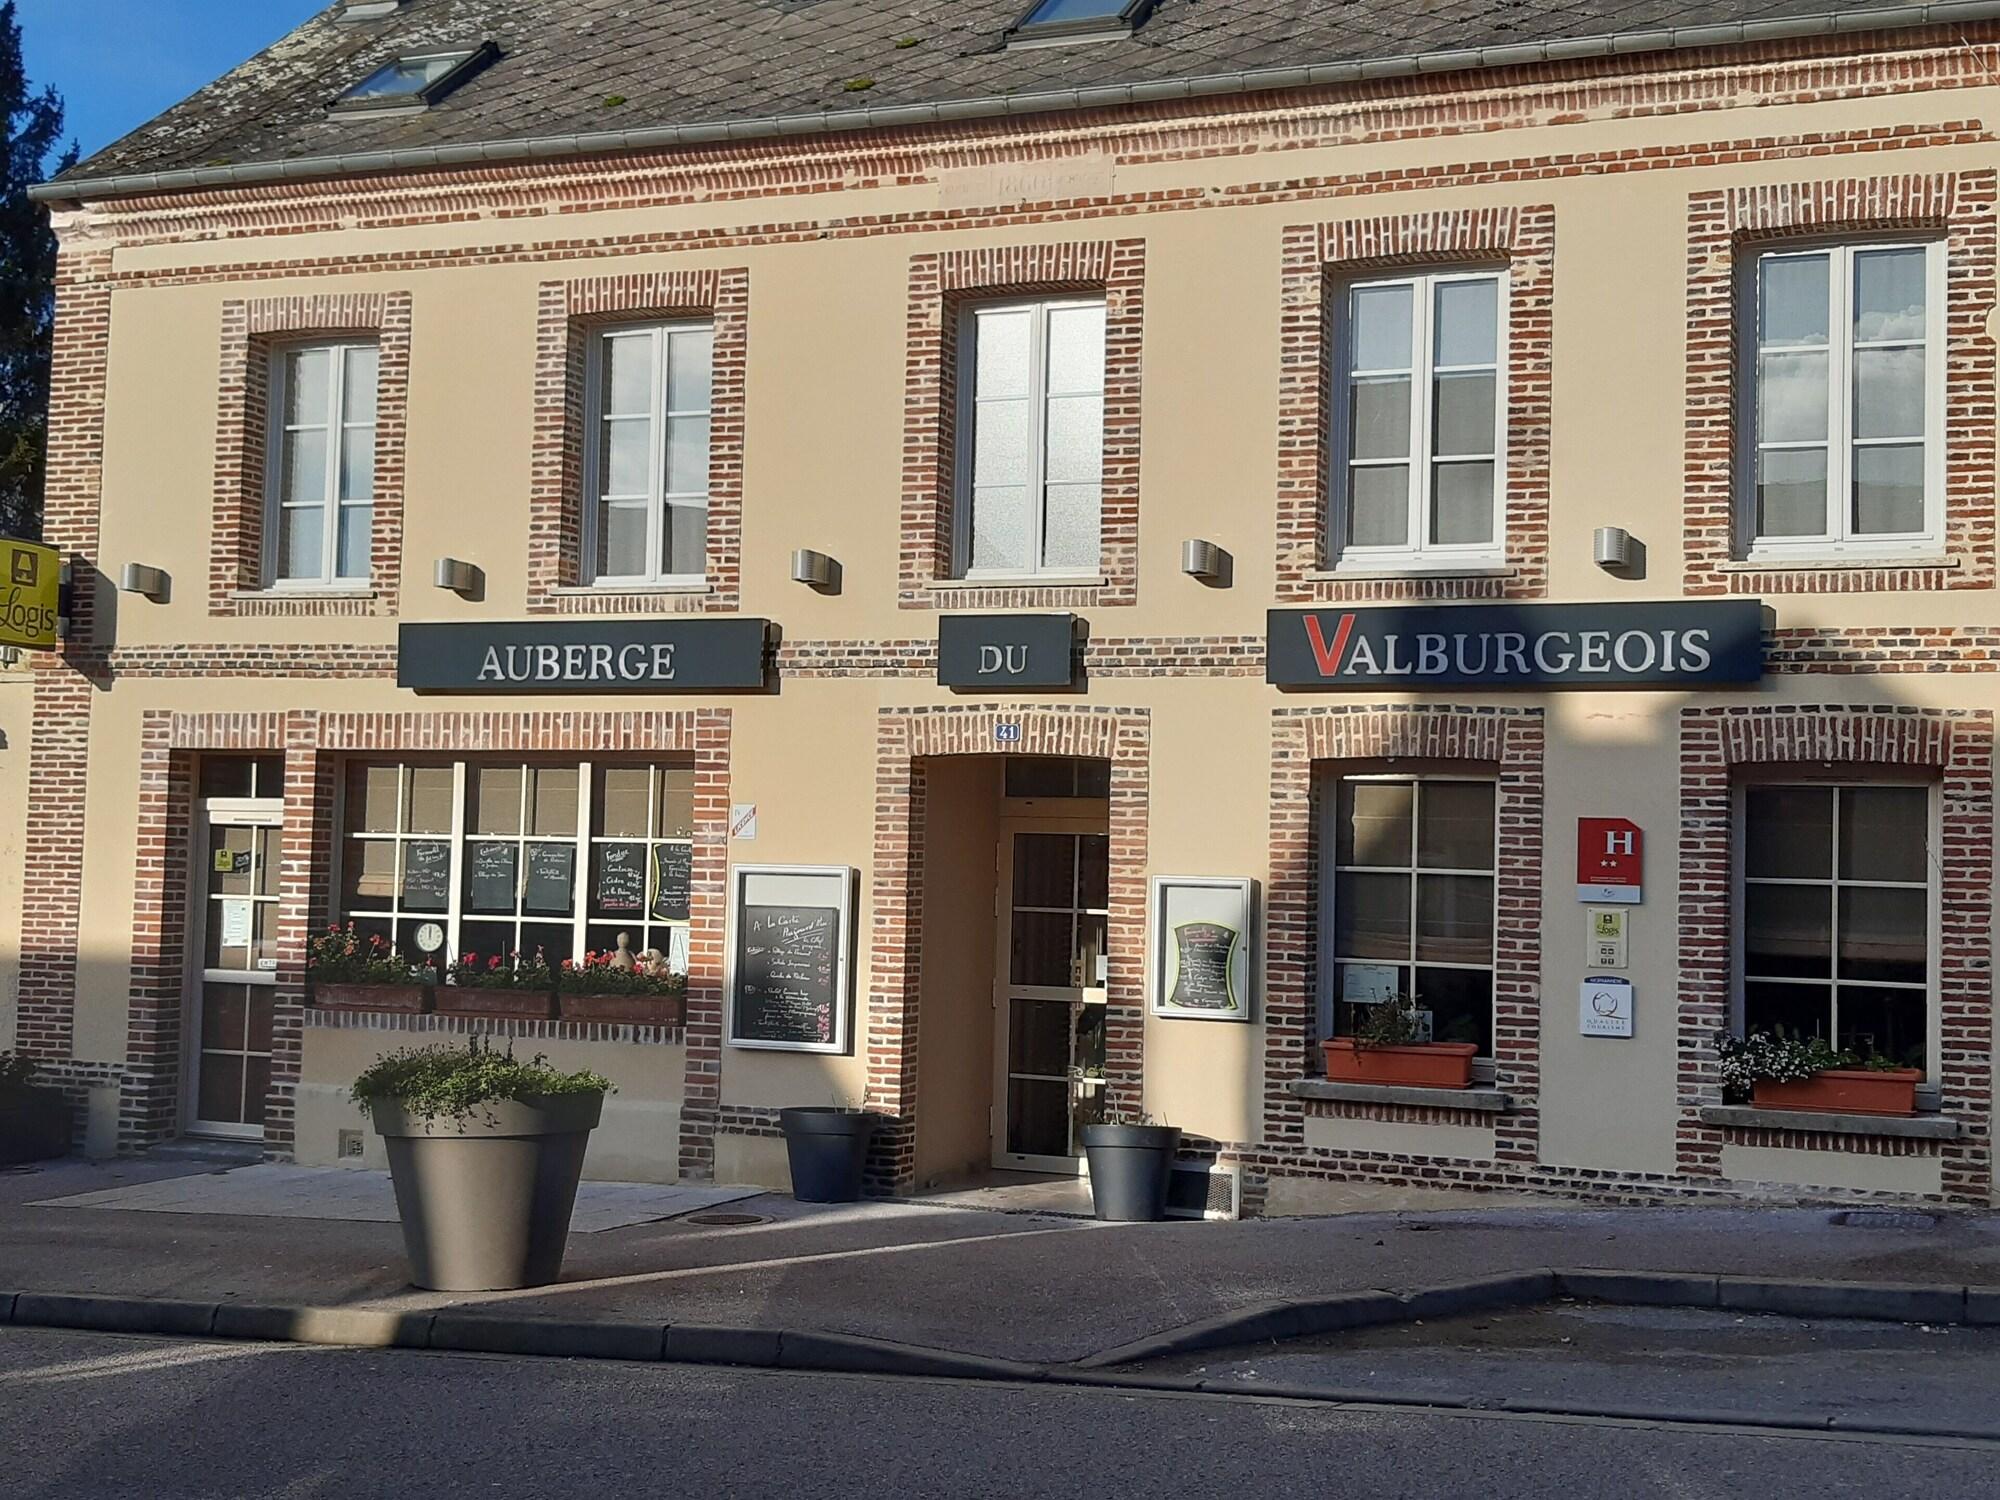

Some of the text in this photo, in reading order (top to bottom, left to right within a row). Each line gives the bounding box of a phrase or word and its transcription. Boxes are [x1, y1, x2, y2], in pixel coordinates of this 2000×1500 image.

[0, 586, 54, 637] Logis
[978, 645, 1028, 674] DU
[1302, 613, 1711, 677] VALBURGEOIS
[477, 644, 675, 681] AUBERGE
[999, 726, 1015, 739] 41
[606, 849, 630, 861] Fondue
[1604, 831, 1634, 855] H
